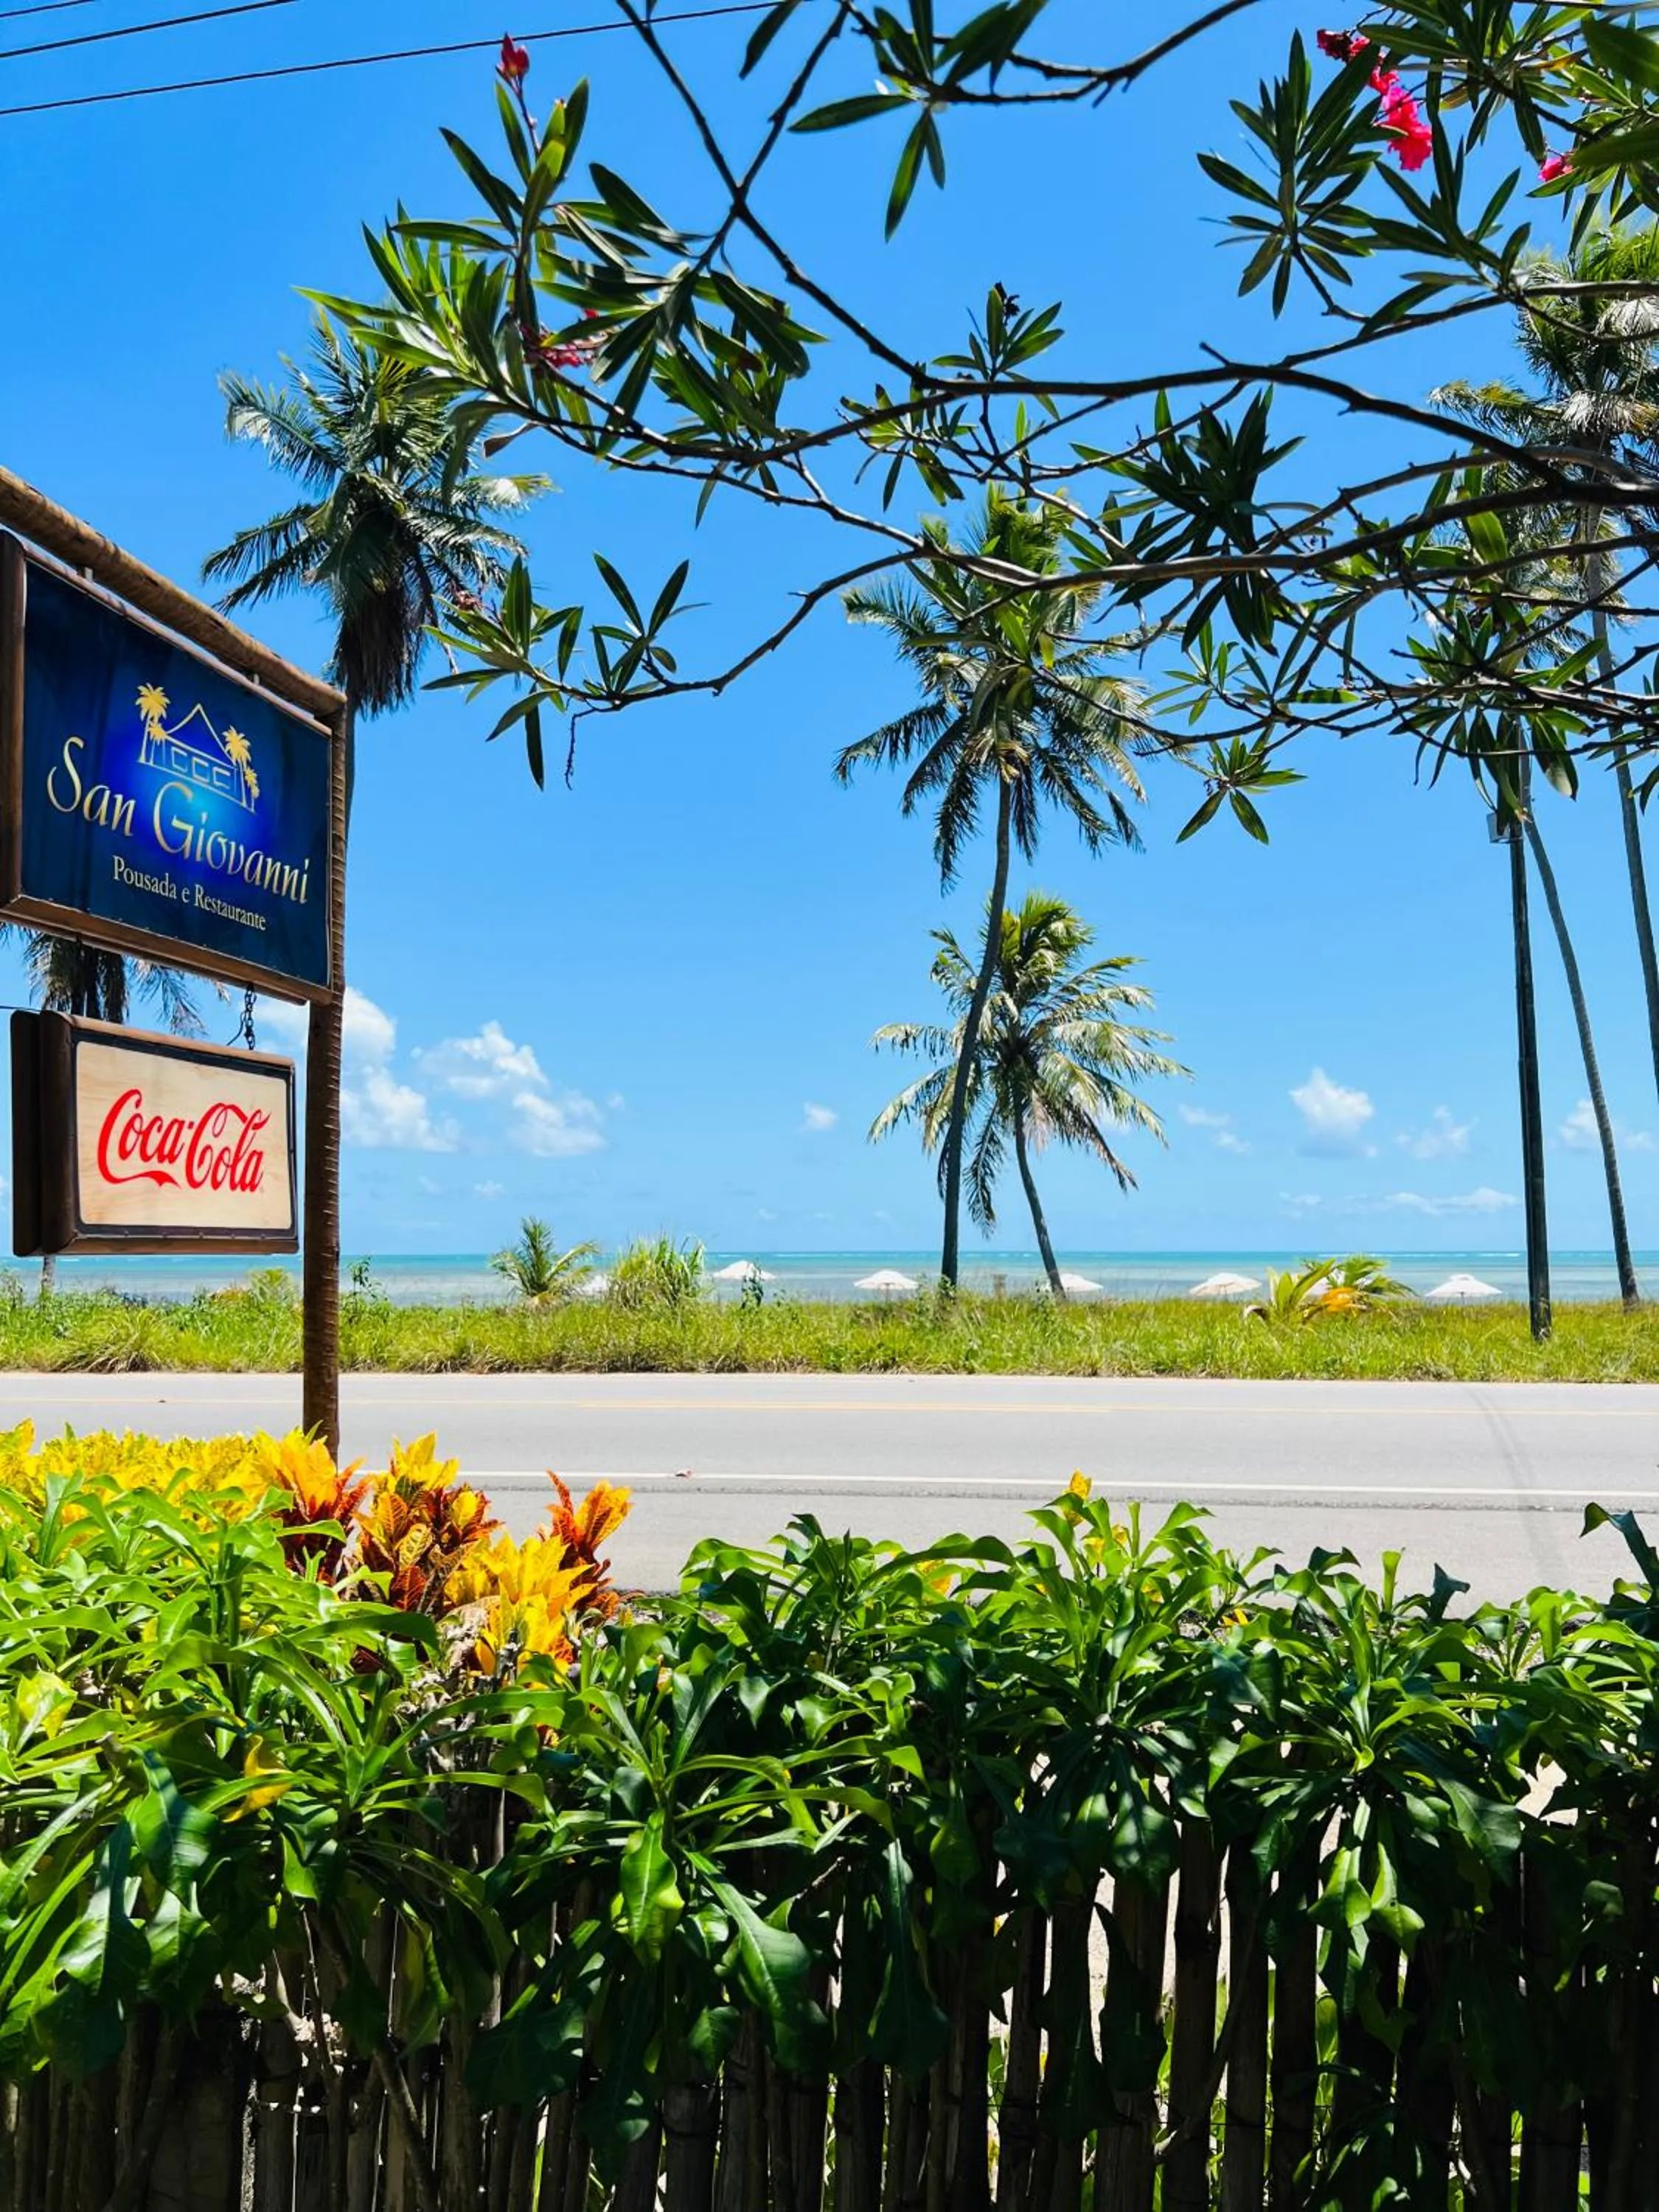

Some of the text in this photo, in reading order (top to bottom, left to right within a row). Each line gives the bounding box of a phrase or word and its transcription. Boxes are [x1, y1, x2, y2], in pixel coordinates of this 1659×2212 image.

[46, 737, 309, 904] San Giovanni
[114, 855, 266, 932] Pousada e Restaurante
